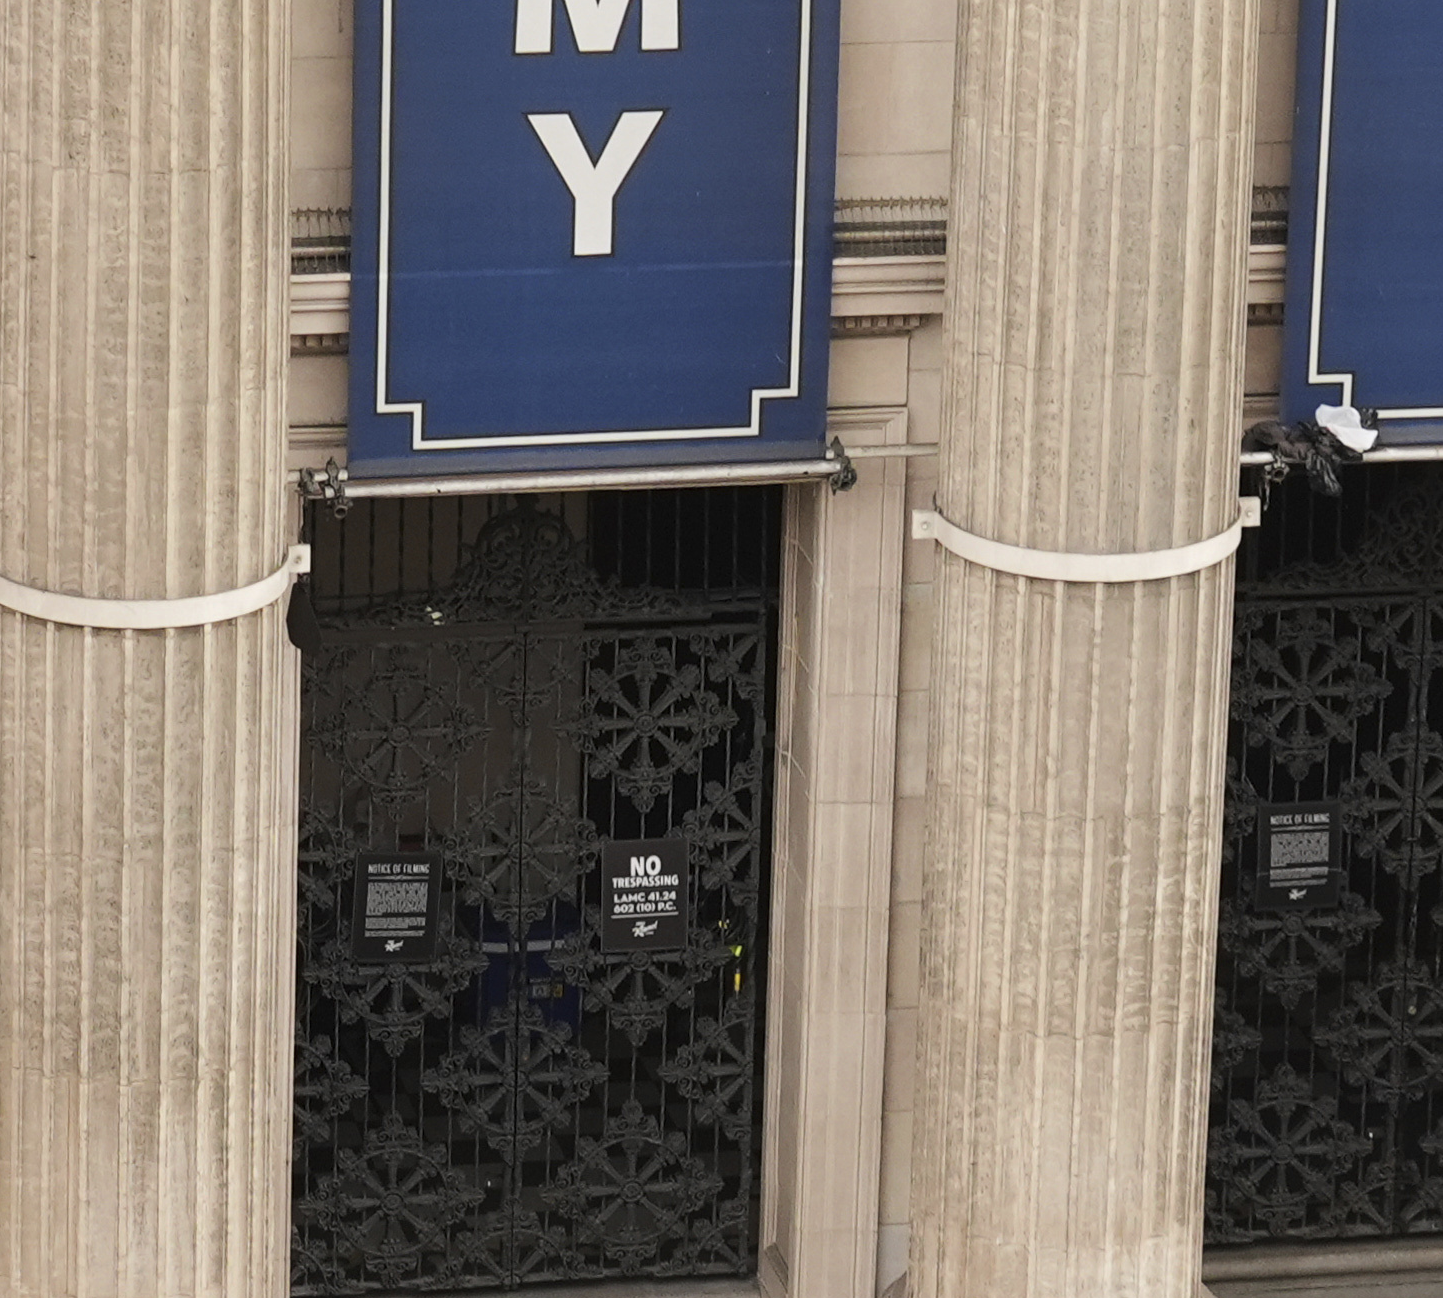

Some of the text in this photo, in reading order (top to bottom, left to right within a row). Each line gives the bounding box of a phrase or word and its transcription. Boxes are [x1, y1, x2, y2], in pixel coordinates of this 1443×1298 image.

[630, 854, 662, 877] NO
[612, 874, 679, 889] TRESPASSING
[613, 891, 677, 903] LAMC 41.24
[613, 904, 635, 914] 602
